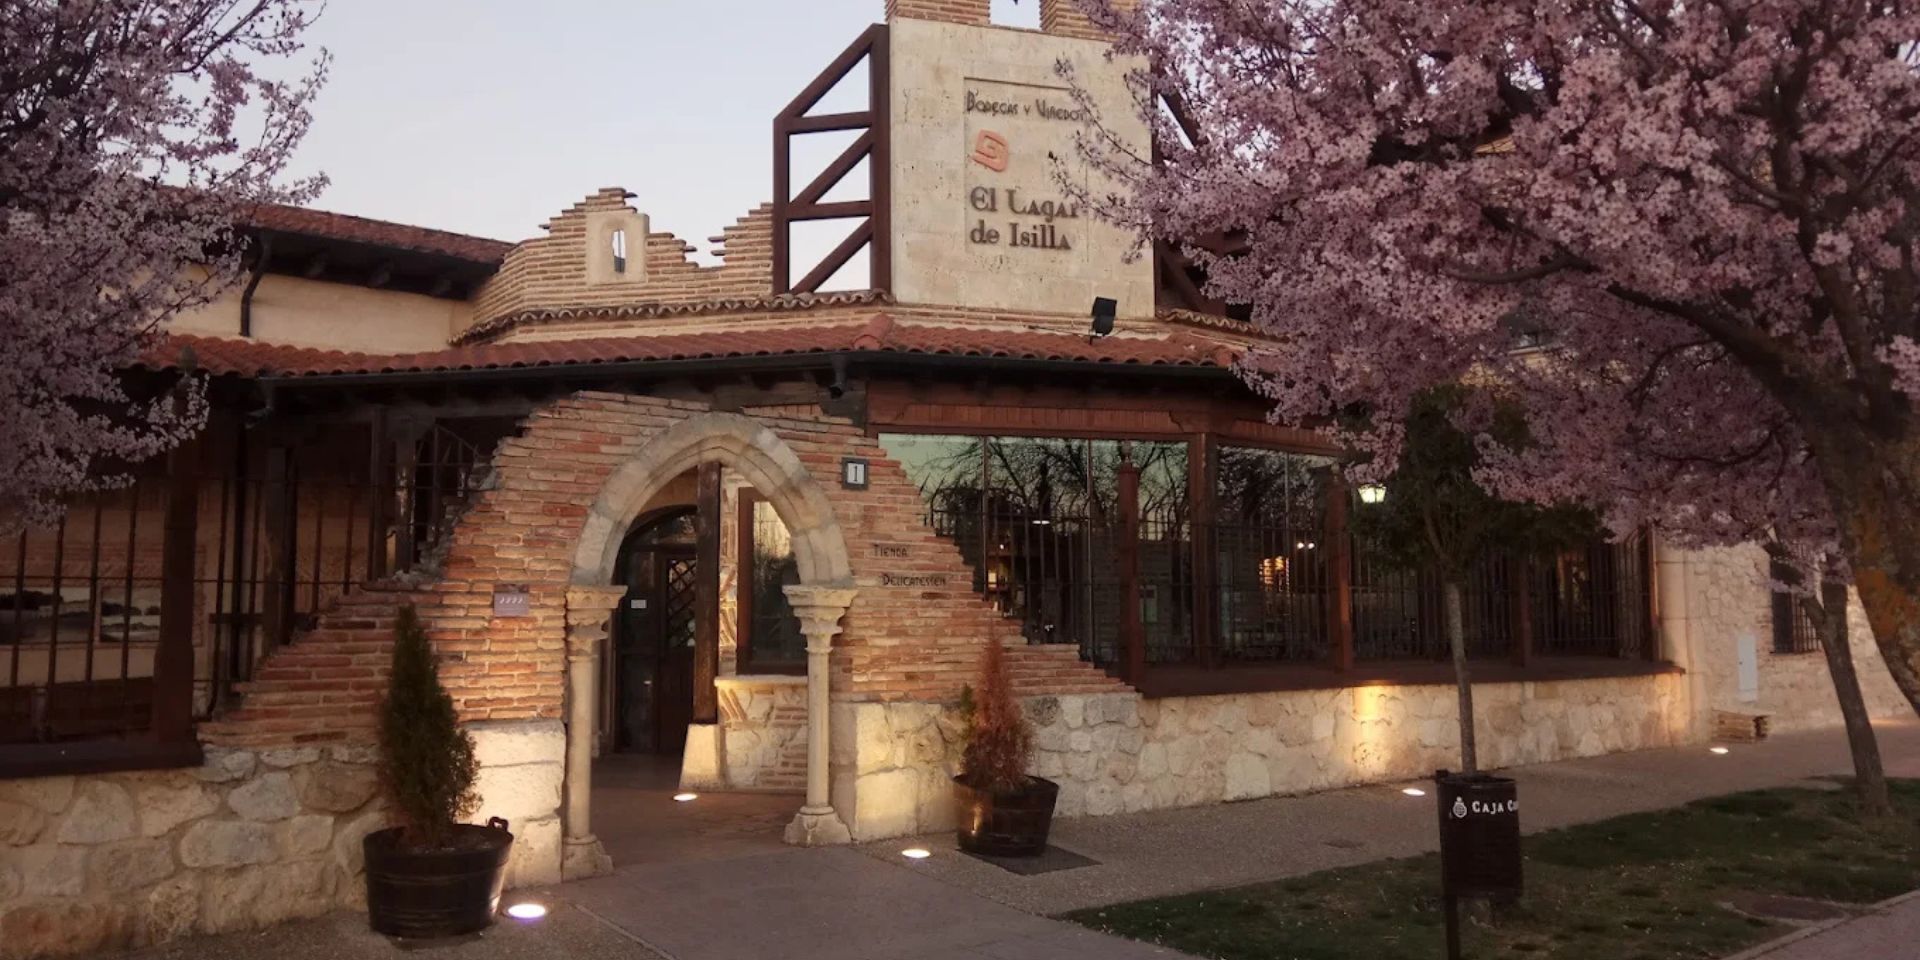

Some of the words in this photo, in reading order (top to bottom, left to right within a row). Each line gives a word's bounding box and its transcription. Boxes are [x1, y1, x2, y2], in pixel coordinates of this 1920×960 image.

[970, 186, 997, 212] El
[970, 219, 1000, 244] de
[1472, 801, 1504, 815] CAJA
